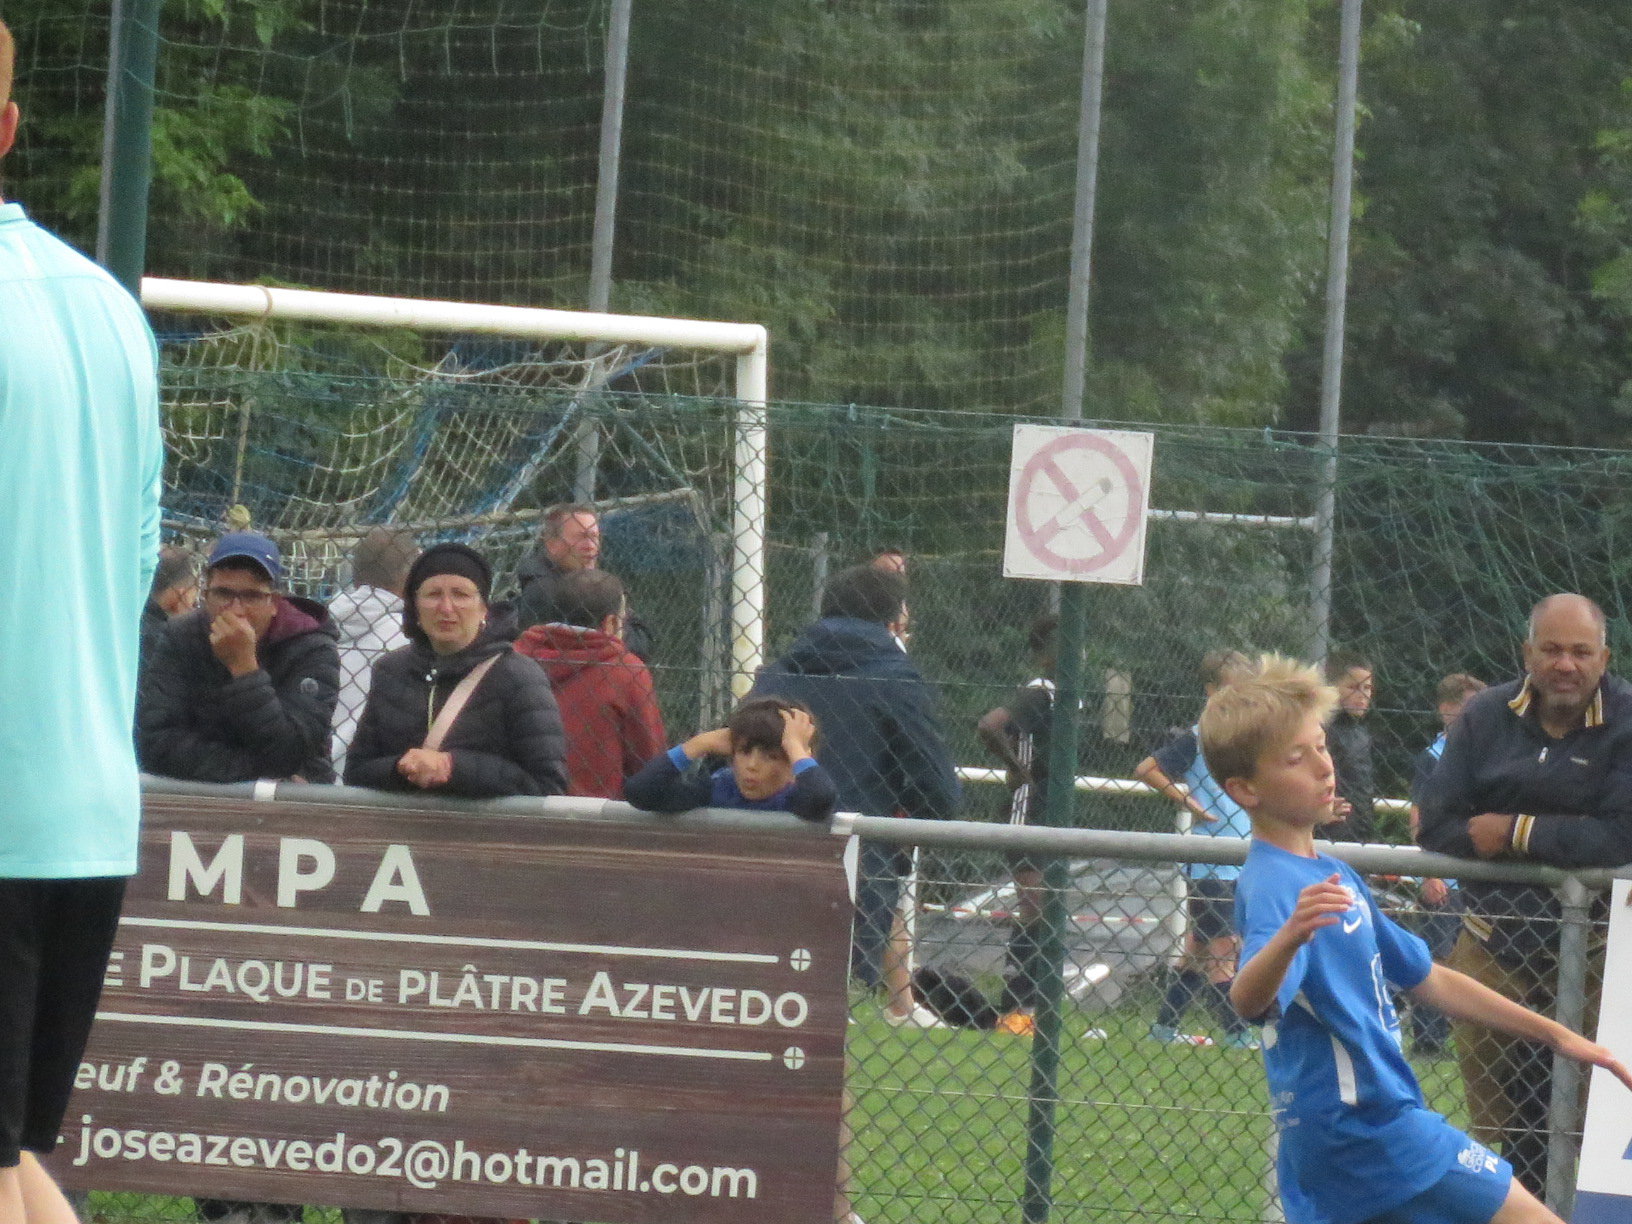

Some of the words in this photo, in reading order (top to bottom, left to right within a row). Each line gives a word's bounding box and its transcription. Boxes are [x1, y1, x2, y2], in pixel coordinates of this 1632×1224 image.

[140, 943, 332, 1003] PLAQUE
[345, 978, 384, 1003] DE
[398, 963, 567, 1014] PLÂTRE
[578, 971, 809, 1028] AZEVEDO
[74, 1056, 148, 1092] euf
[153, 1060, 183, 1095] &
[197, 1063, 450, 1112] Rénovation
[73, 1114, 757, 1199] joseazevedo2@hotmail.com
